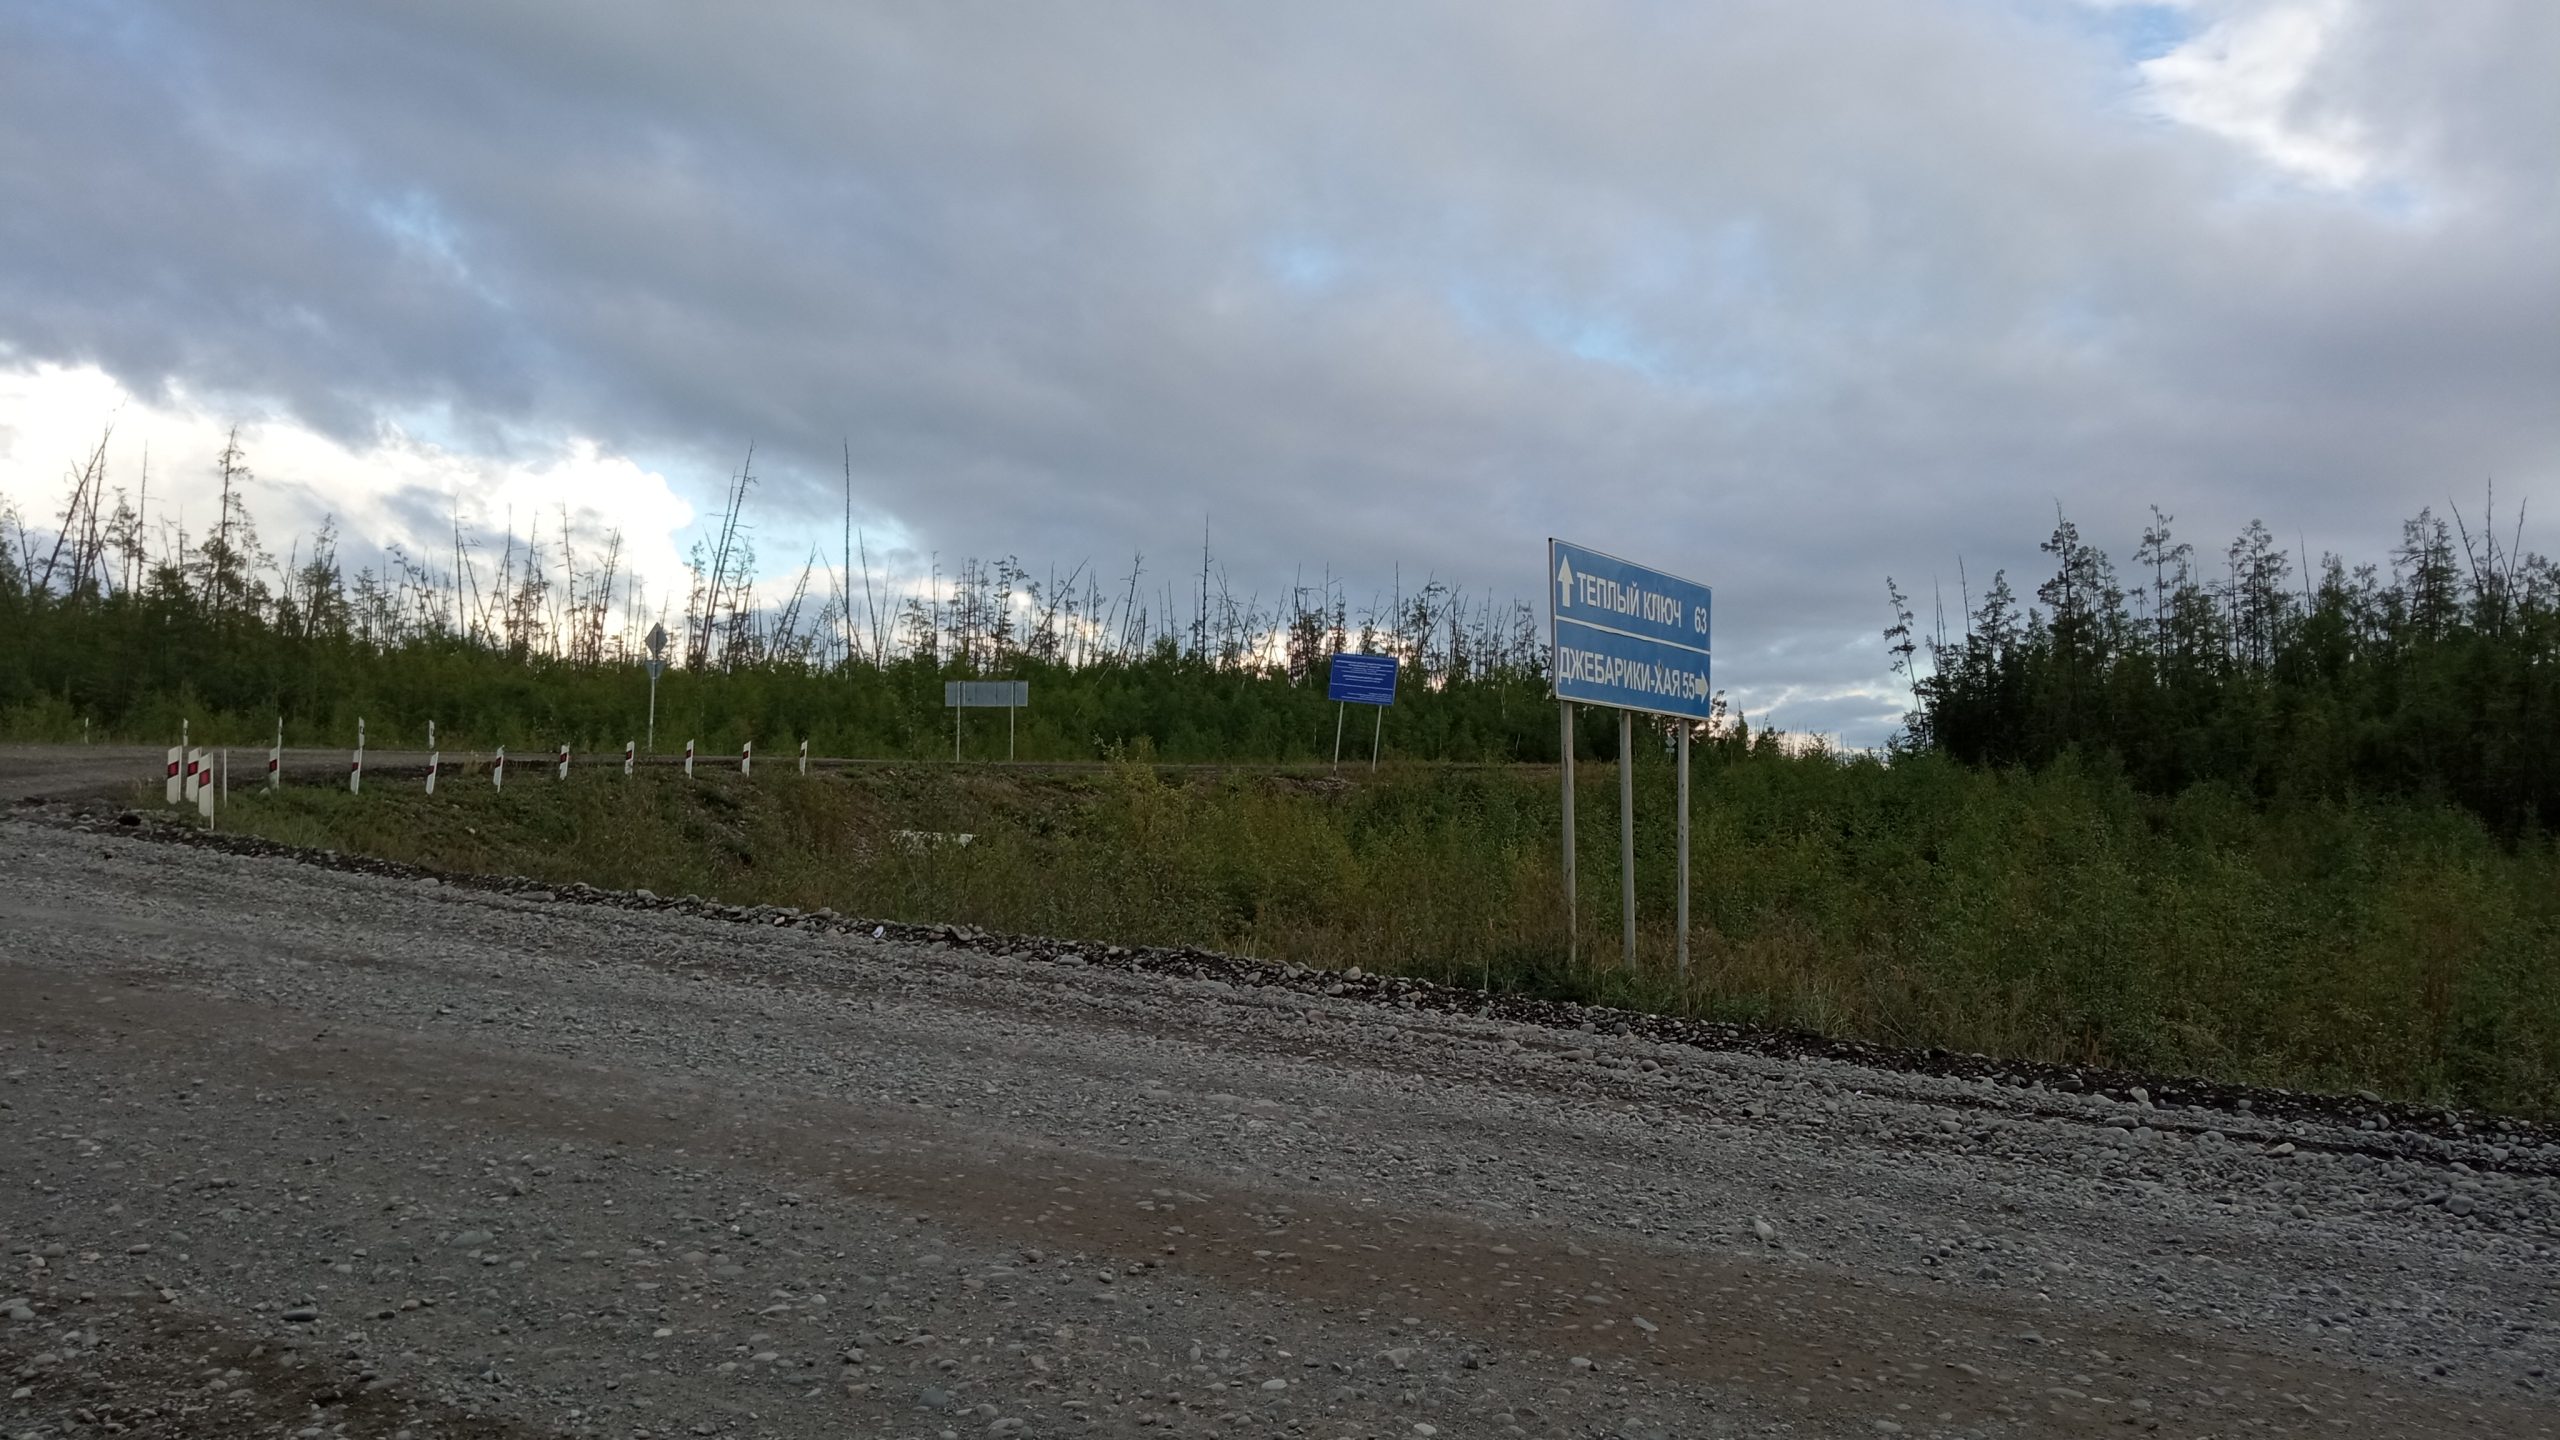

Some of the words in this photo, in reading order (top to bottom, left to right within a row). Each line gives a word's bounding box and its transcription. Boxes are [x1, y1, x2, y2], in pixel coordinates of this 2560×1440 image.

[1577, 572, 1640, 618] ТЕПЛЫЙ
[1643, 590, 1682, 628] КЛЮЧ
[1694, 606, 1707, 635] 63
[1558, 646, 1681, 698] ДЖЕБАРИКИ-ХАЯ
[1682, 672, 1695, 700] 55
